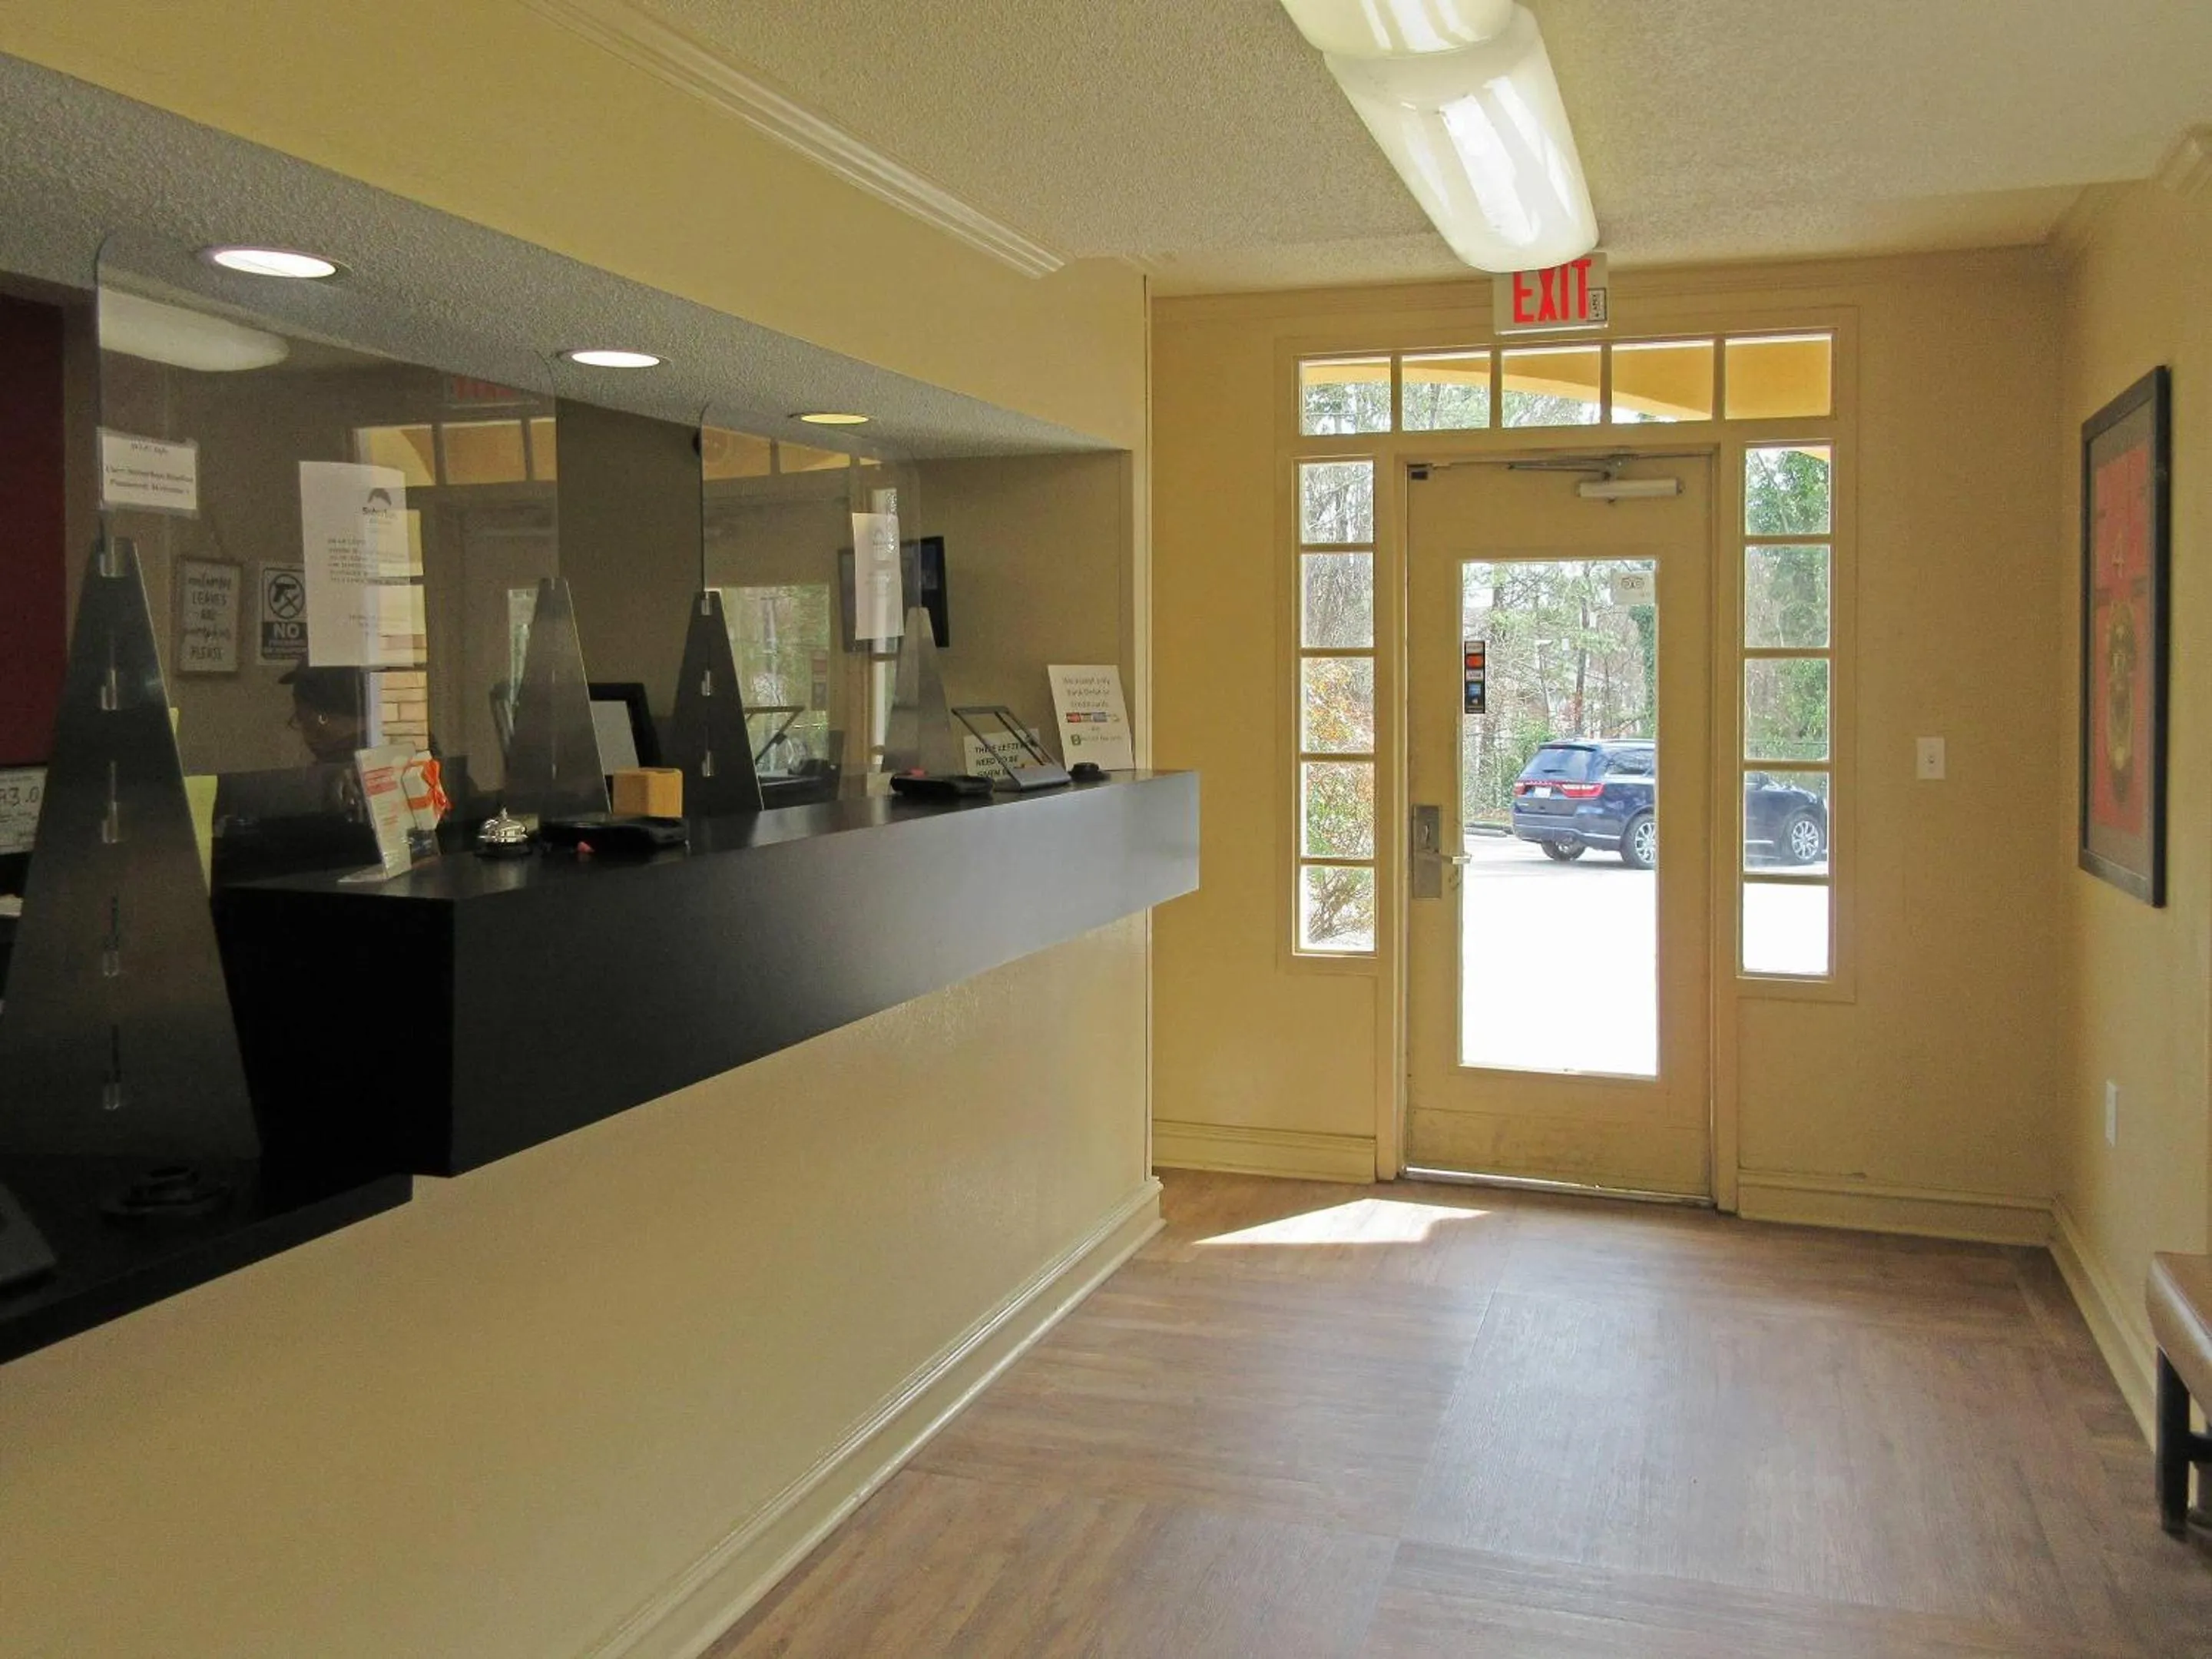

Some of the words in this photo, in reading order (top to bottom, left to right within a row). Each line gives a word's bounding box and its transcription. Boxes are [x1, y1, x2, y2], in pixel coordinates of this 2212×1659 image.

[1513, 258, 1592, 323] EXIT
[273, 623, 300, 639] NO
[975, 744, 997, 753] THEE
